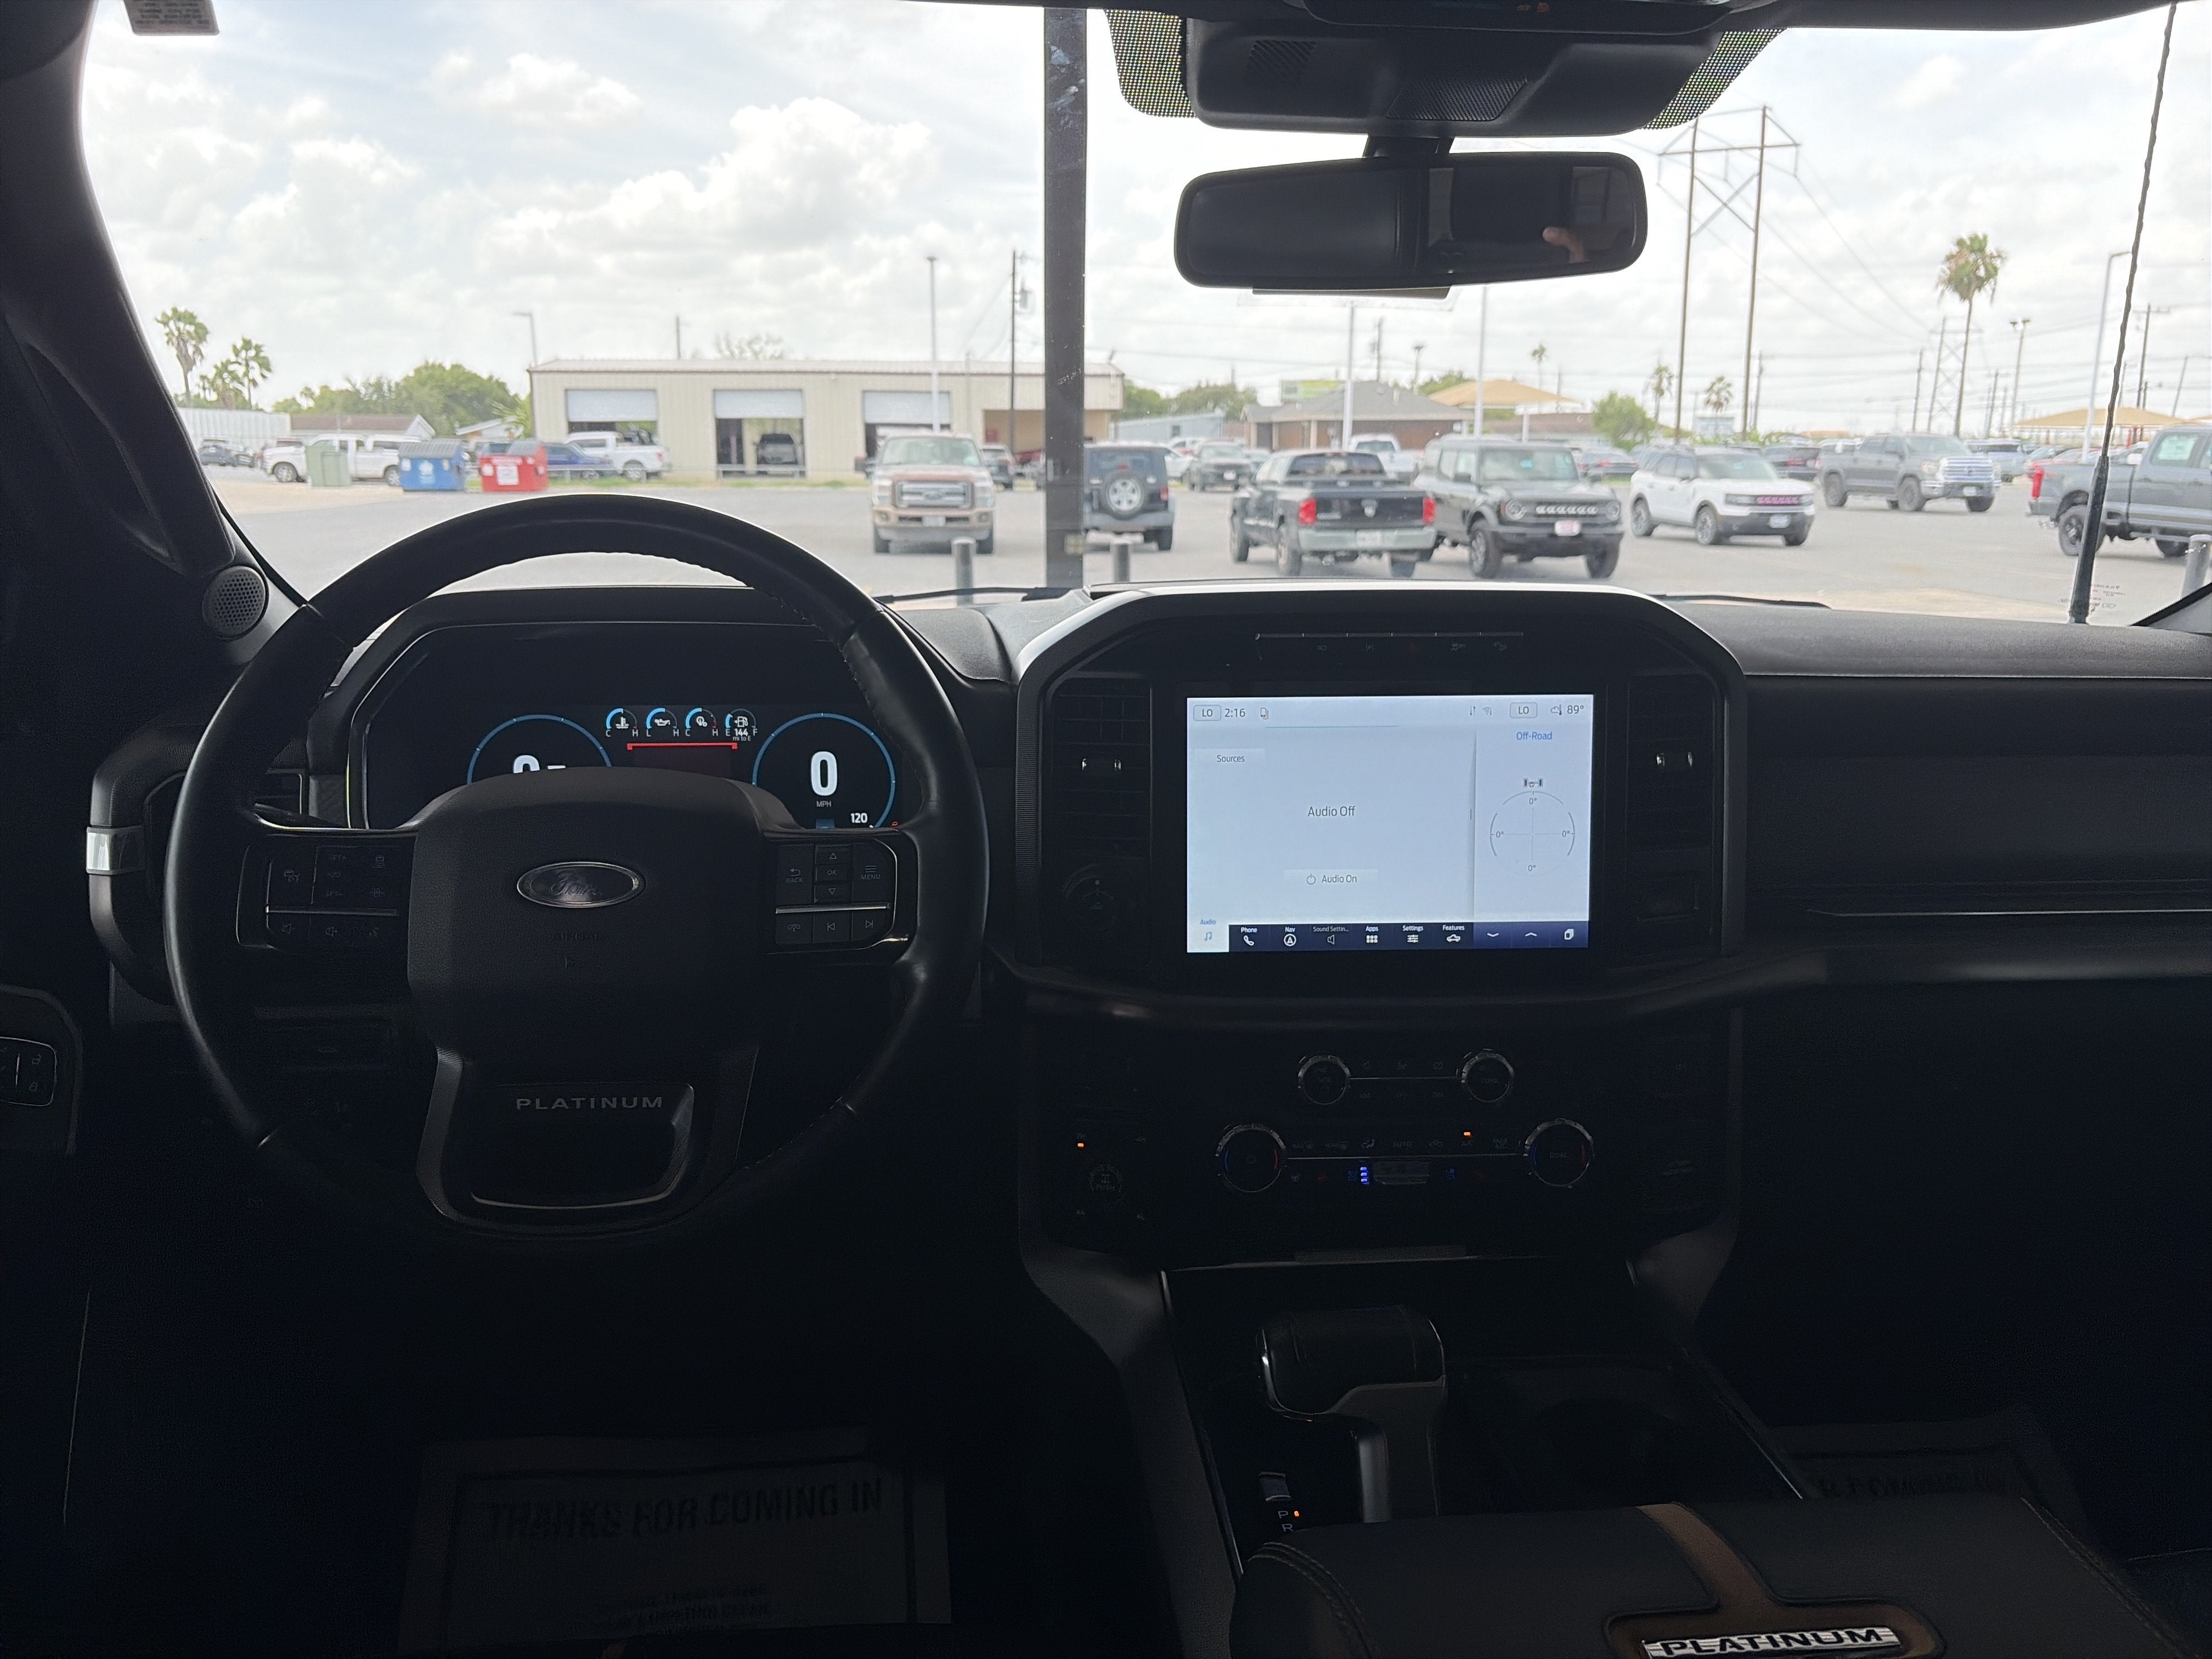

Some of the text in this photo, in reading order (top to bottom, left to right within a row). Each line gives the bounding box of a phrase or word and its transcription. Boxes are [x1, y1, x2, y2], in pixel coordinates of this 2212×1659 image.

[1202, 709, 1213, 718] LO
[1224, 708, 1246, 718] 2:16
[646, 729, 652, 737] L
[735, 728, 749, 736] 144
[1516, 731, 1553, 740] Off-Road
[1217, 754, 1245, 763] Sources
[811, 751, 838, 796] 0
[1308, 805, 1356, 817] Audio Off
[850, 812, 868, 823] 120
[550, 868, 609, 896] For
[516, 1096, 663, 1110] PLATINUM
[486, 1477, 883, 1541] THANKS FOR COMING IN
[1277, 1510, 1289, 1519] P
[1282, 1523, 1294, 1532] R
[1660, 1629, 1882, 1655] PLATINUM
